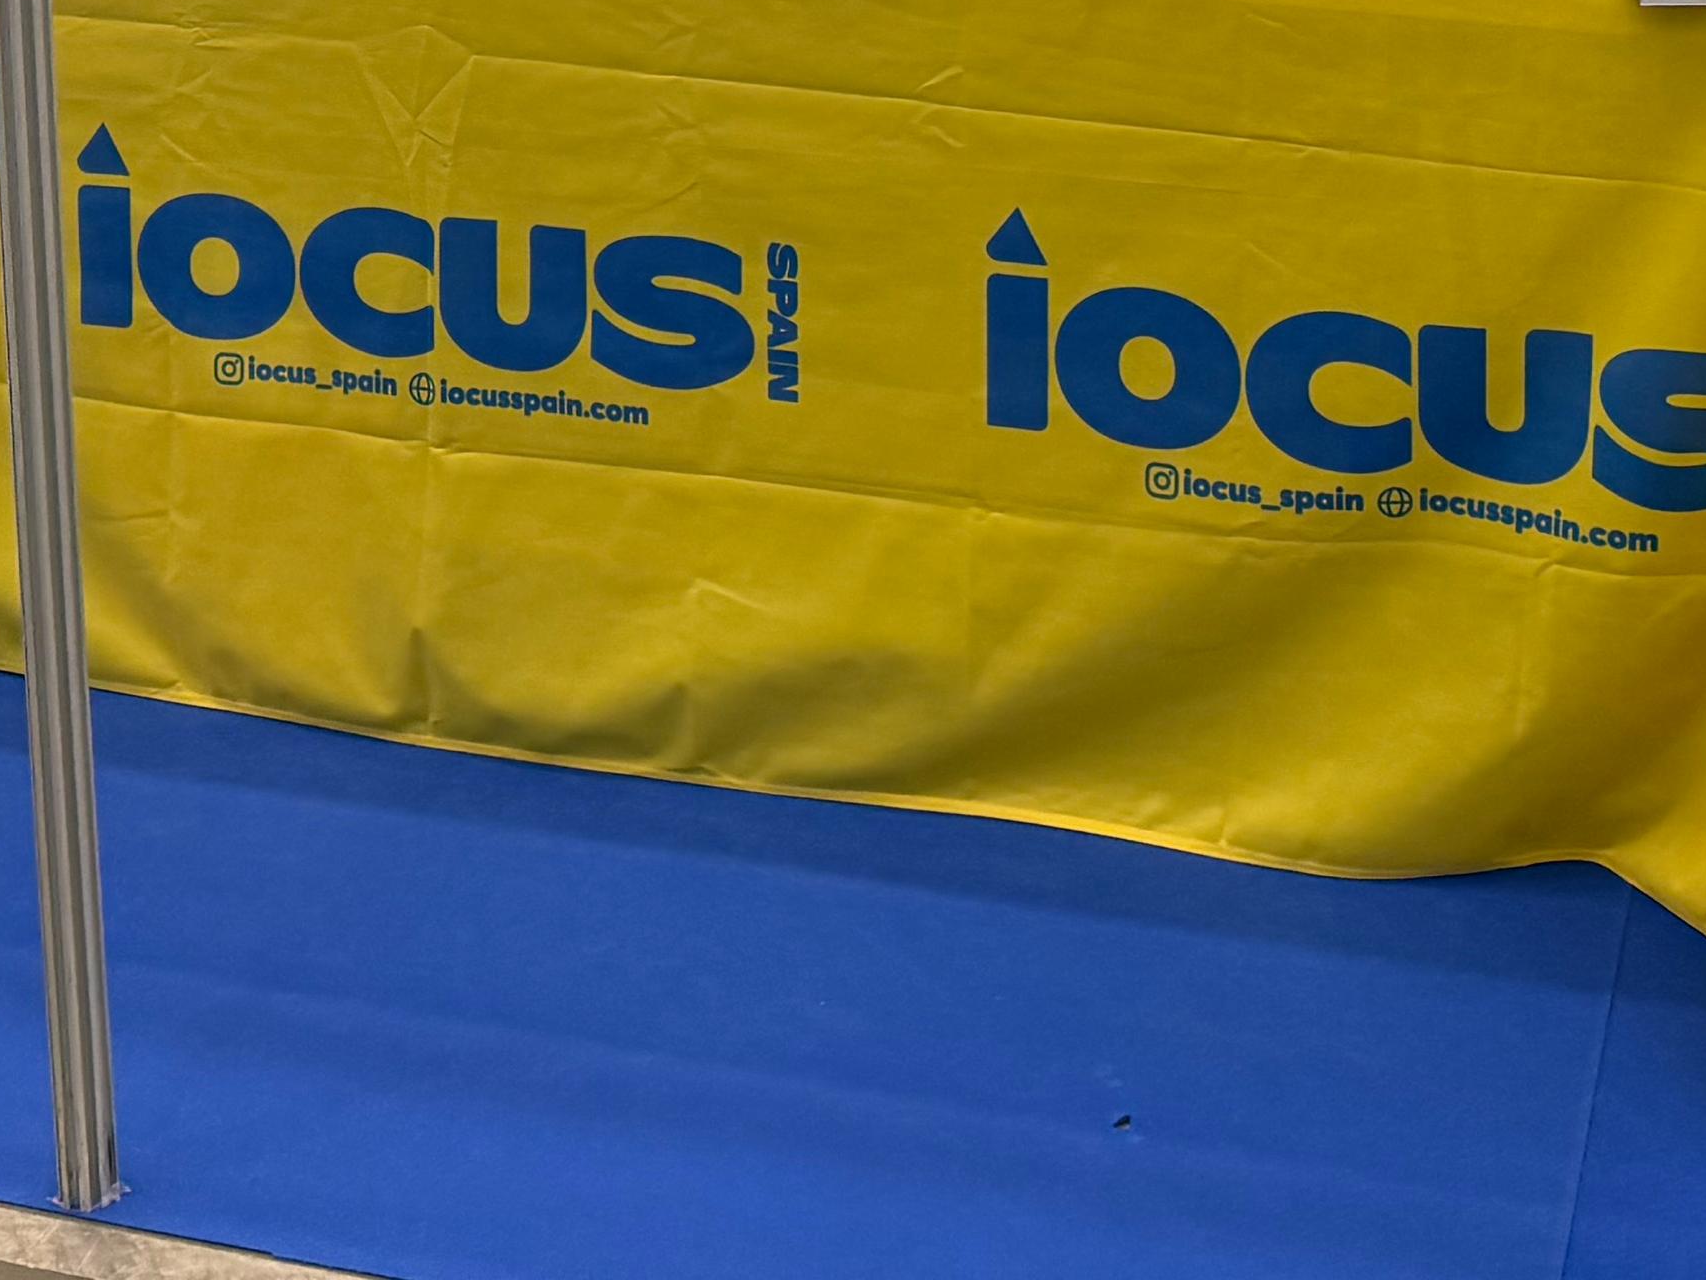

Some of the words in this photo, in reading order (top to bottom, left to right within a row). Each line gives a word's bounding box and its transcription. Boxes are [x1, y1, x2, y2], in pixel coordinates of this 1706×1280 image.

[766, 241, 801, 403] SPAIN
[247, 354, 398, 398] iocus_spain
[439, 378, 651, 426] iocusspain.com
[1182, 467, 1365, 514] iocus_spain
[1418, 485, 1660, 554] iocusspain.com
